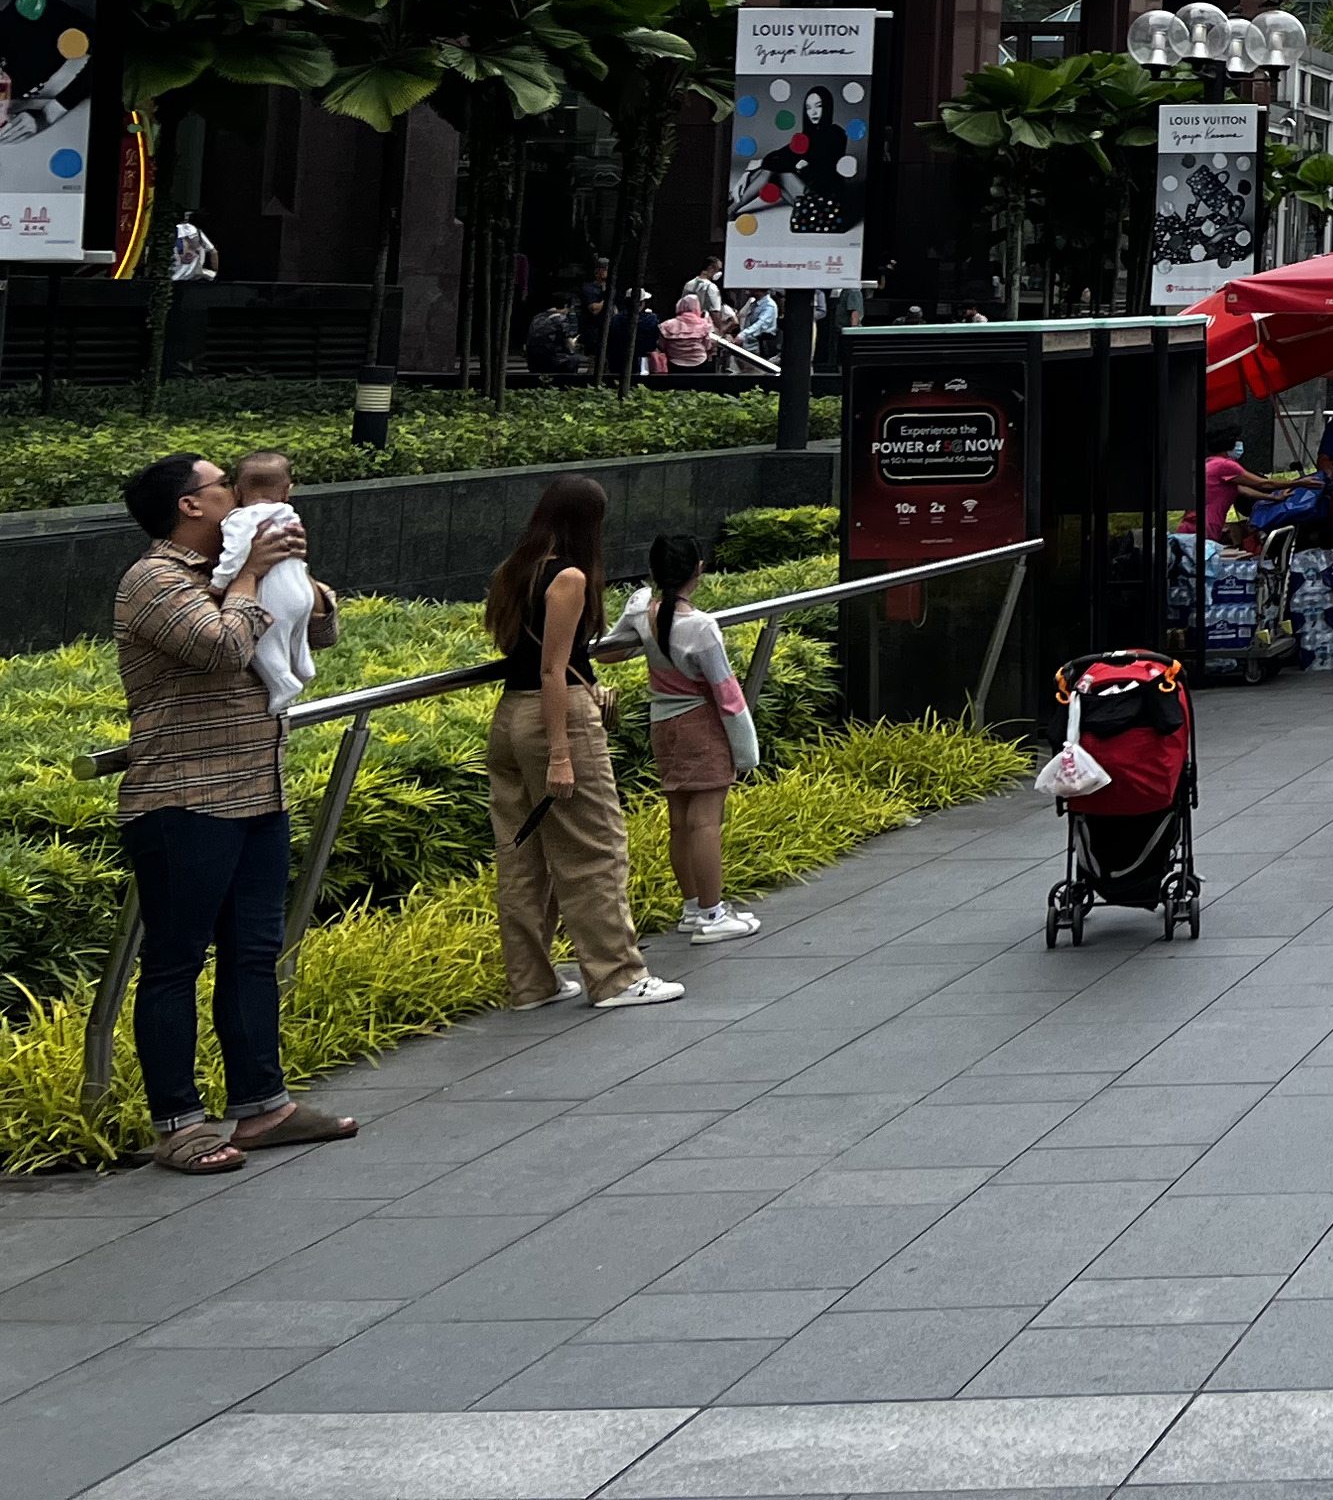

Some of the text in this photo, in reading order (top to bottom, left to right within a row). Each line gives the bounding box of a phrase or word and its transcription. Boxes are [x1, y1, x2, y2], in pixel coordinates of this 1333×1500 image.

[753, 25, 859, 36] LOUIS VUITTON
[1169, 116, 1247, 125] LOUIS VUITTON
[900, 424, 978, 438] Experience the
[871, 439, 1004, 454] POWER of 5G NOW
[895, 503, 917, 514] 10x
[929, 502, 946, 513] 2x
